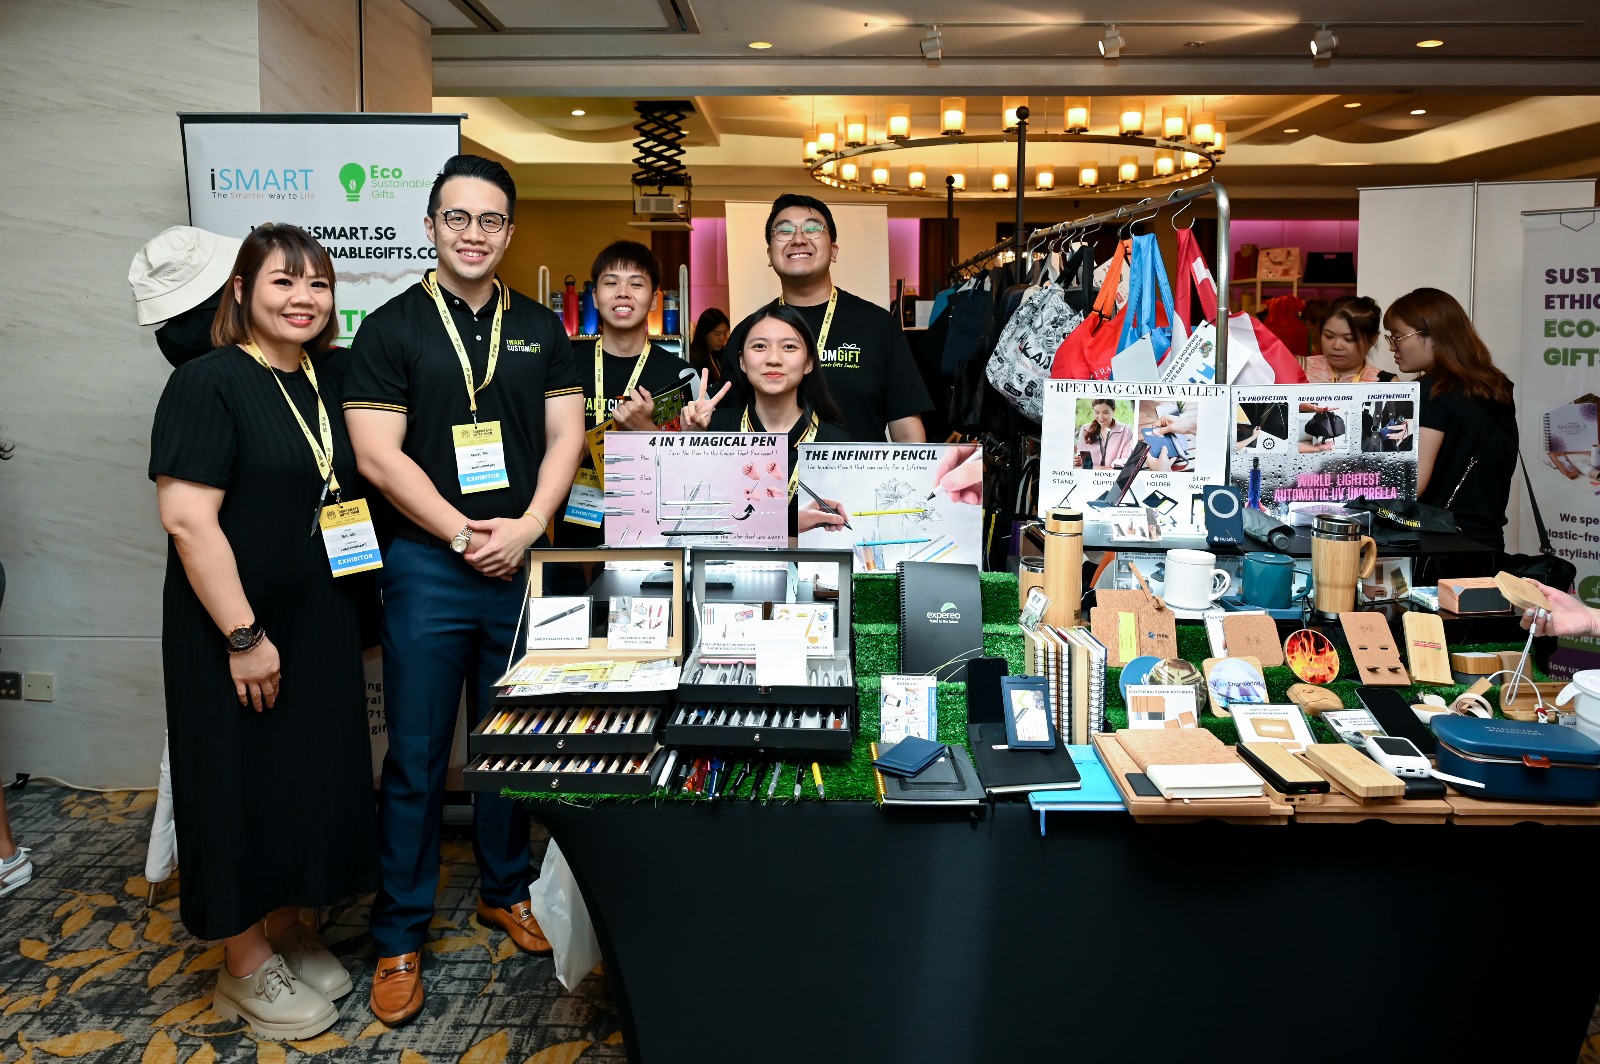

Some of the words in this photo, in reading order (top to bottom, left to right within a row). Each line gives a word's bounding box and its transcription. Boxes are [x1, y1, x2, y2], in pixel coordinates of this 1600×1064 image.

[370, 164, 402, 179] Eco
[210, 168, 314, 191] iSMART
[371, 179, 431, 188] Sustainable
[212, 191, 228, 199] The
[230, 191, 265, 199] Smarter
[268, 192, 286, 200] way
[300, 192, 315, 200] Life
[371, 190, 395, 199] Gifts
[331, 246, 438, 259] NABLEGIFTS.CO
[1189, 338, 1203, 357] POUCH
[821, 350, 860, 363] OMGIFT
[1543, 347, 1600, 366] GIFT
[1056, 382, 1089, 393] RPET
[1093, 383, 1122, 395] MAG
[1126, 384, 1162, 396] CARD
[1167, 386, 1220, 397] WALLET
[649, 436, 657, 447] 4
[660, 436, 674, 447] IN
[679, 436, 685, 447] 1
[689, 436, 747, 447] MAGICAL
[751, 436, 777, 447] PEN
[805, 450, 829, 461] THE
[832, 450, 889, 460] INFINITY
[892, 449, 937, 460] PENCIL
[466, 472, 500, 483] EXHIBITOR
[1297, 473, 1331, 487] WORLD
[1336, 472, 1380, 486] LIGHTEST
[1274, 488, 1329, 502] AUTOMATIC
[1331, 487, 1344, 500] UV
[1347, 486, 1397, 500] UMBRELLA
[571, 508, 598, 519] EXHIBITOR
[1560, 513, 1577, 523] We
[1580, 516, 1600, 527] spe
[1548, 529, 1600, 543] lastic-fre
[337, 553, 374, 565] EXHIBITOR
[1559, 548, 1600, 560] stylishl
[926, 611, 961, 620] expereo
